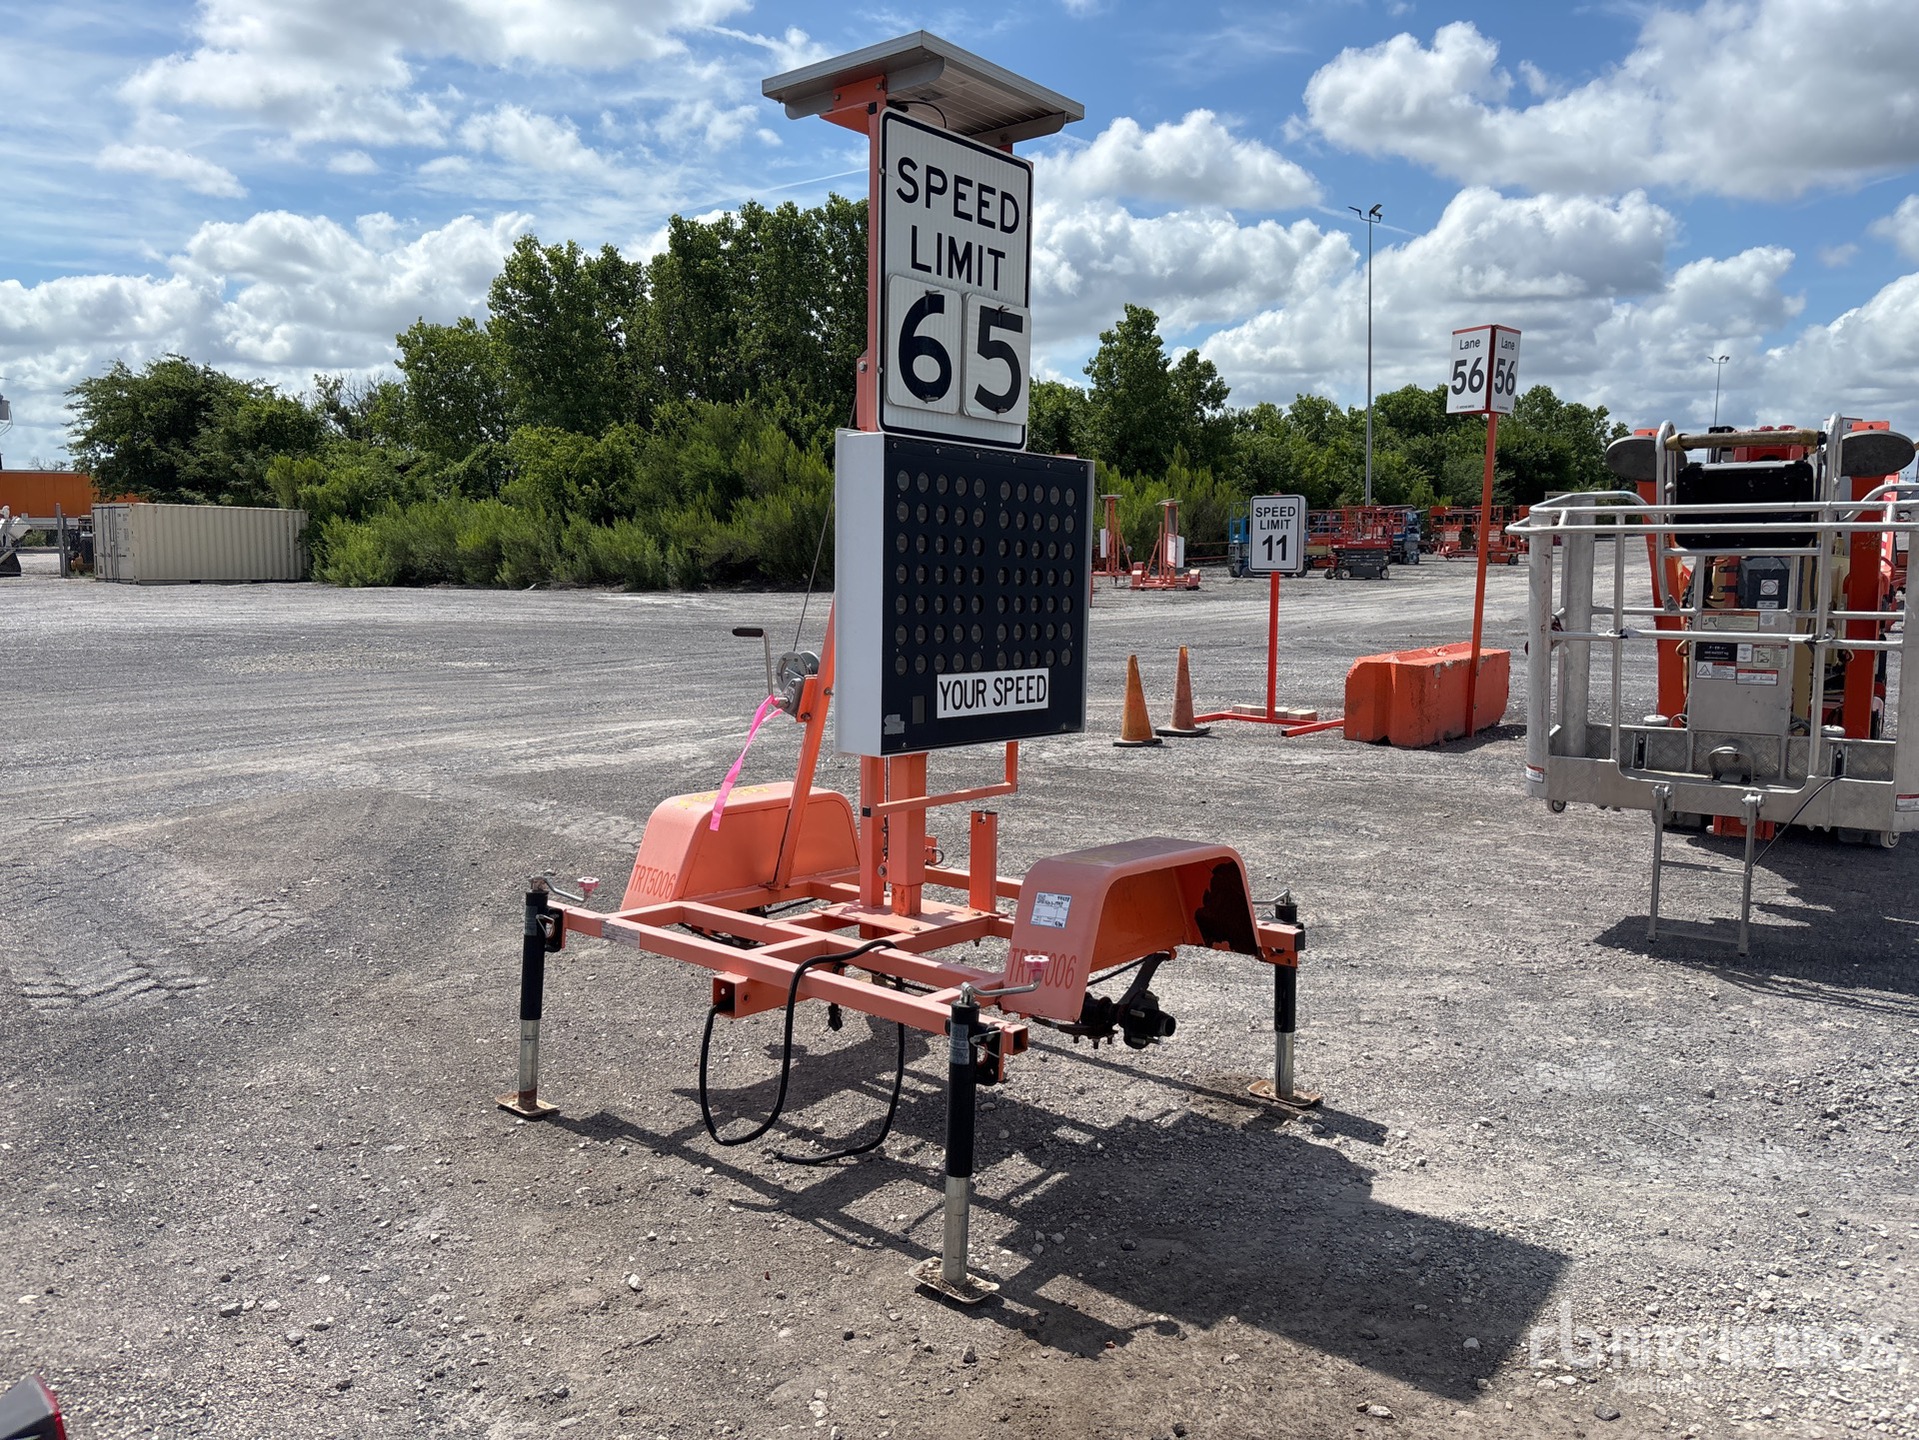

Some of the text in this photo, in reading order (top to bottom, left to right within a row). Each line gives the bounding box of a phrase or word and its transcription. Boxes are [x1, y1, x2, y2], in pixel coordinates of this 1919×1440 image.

[896, 156, 1020, 235] SPEED
[910, 225, 1006, 291] LIMIT
[898, 293, 1024, 414] 65
[1459, 338, 1481, 351] Lane
[1501, 337, 1515, 351] Lane
[1451, 356, 1485, 396] 56
[1494, 357, 1516, 397] 56
[1255, 506, 1296, 518] SPEED
[1259, 519, 1291, 531] LIMIT
[1262, 534, 1288, 562] 11
[939, 674, 1047, 711] YOUR SPEED
[630, 864, 677, 899] TRT5006
